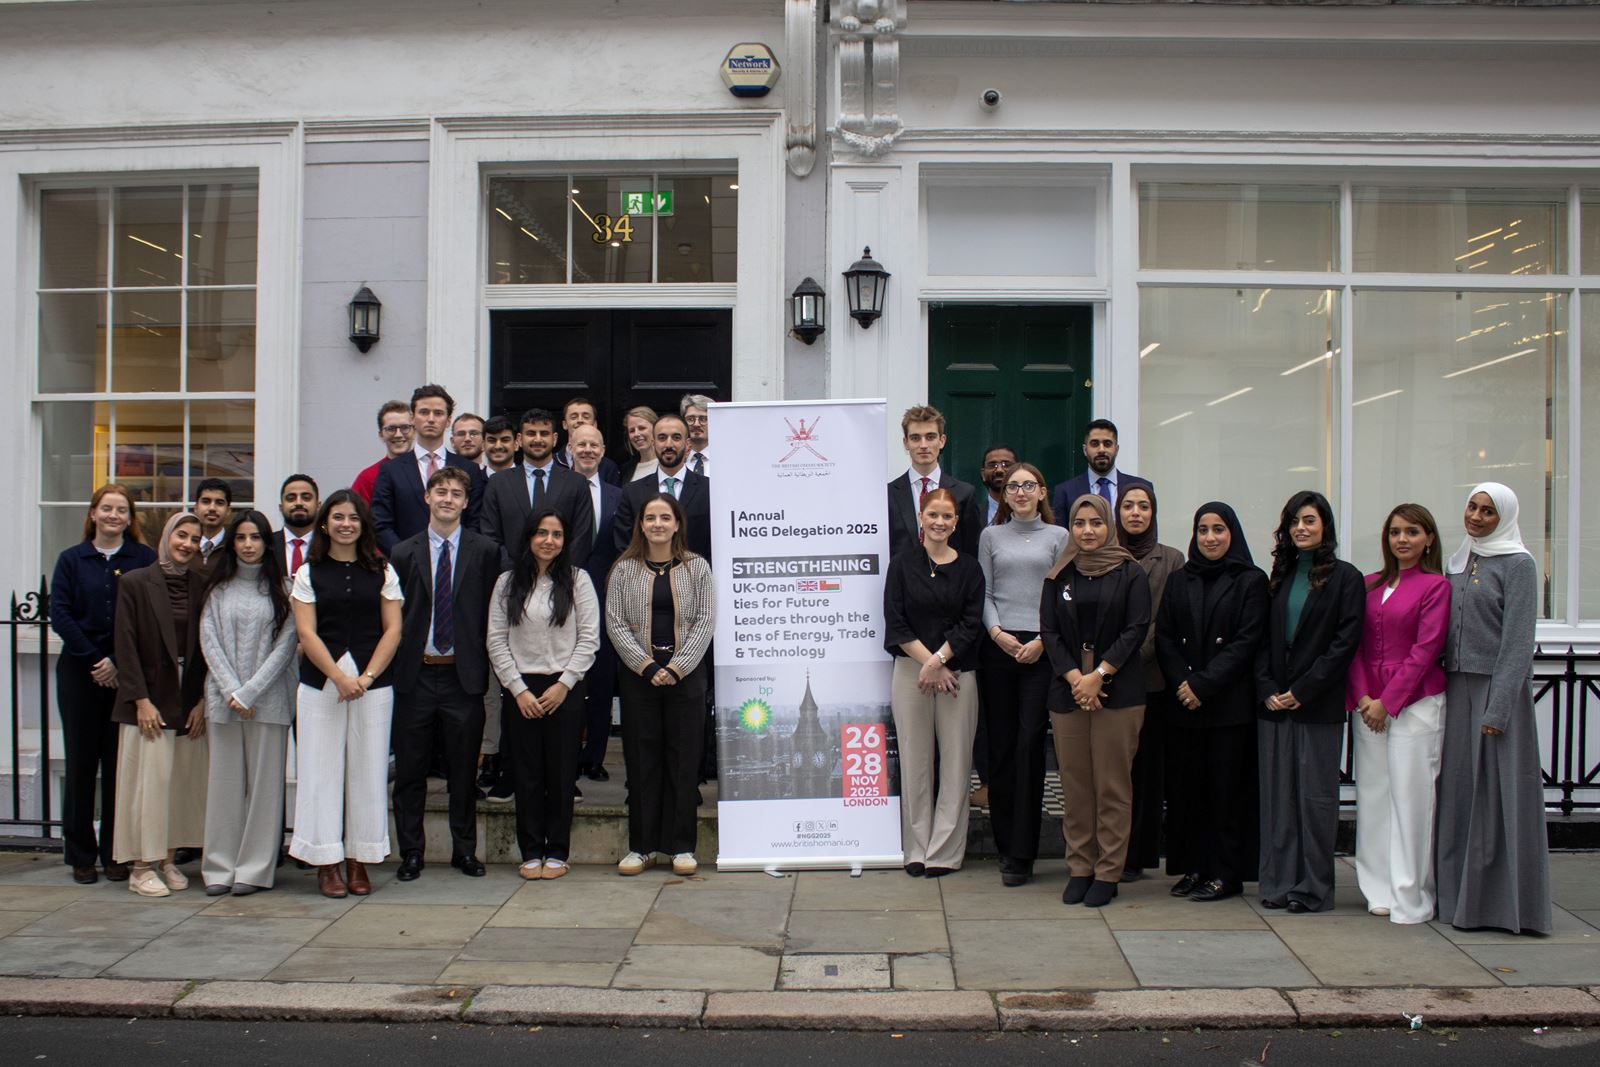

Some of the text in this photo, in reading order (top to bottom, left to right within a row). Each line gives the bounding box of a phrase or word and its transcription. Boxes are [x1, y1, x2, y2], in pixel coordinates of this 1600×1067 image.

[731, 60, 768, 68] Network
[592, 214, 634, 244] 34
[738, 510, 785, 521] Annual
[739, 524, 878, 538] NGG Delegation 2025
[733, 558, 871, 575] STRENGTHENING
[733, 582, 795, 593] UK-Oman
[734, 597, 830, 609] ties for Future
[734, 611, 870, 625] Leaders through the
[735, 628, 876, 642] lens of Energy, Trade
[735, 646, 826, 658] & Technology
[759, 685, 773, 696] bp
[846, 726, 880, 748] 26
[846, 753, 882, 775] 28
[851, 776, 879, 786] NOV
[850, 787, 879, 797] 2025
[843, 798, 888, 807] LONDON
[770, 839, 860, 848] www.britishomani.org
